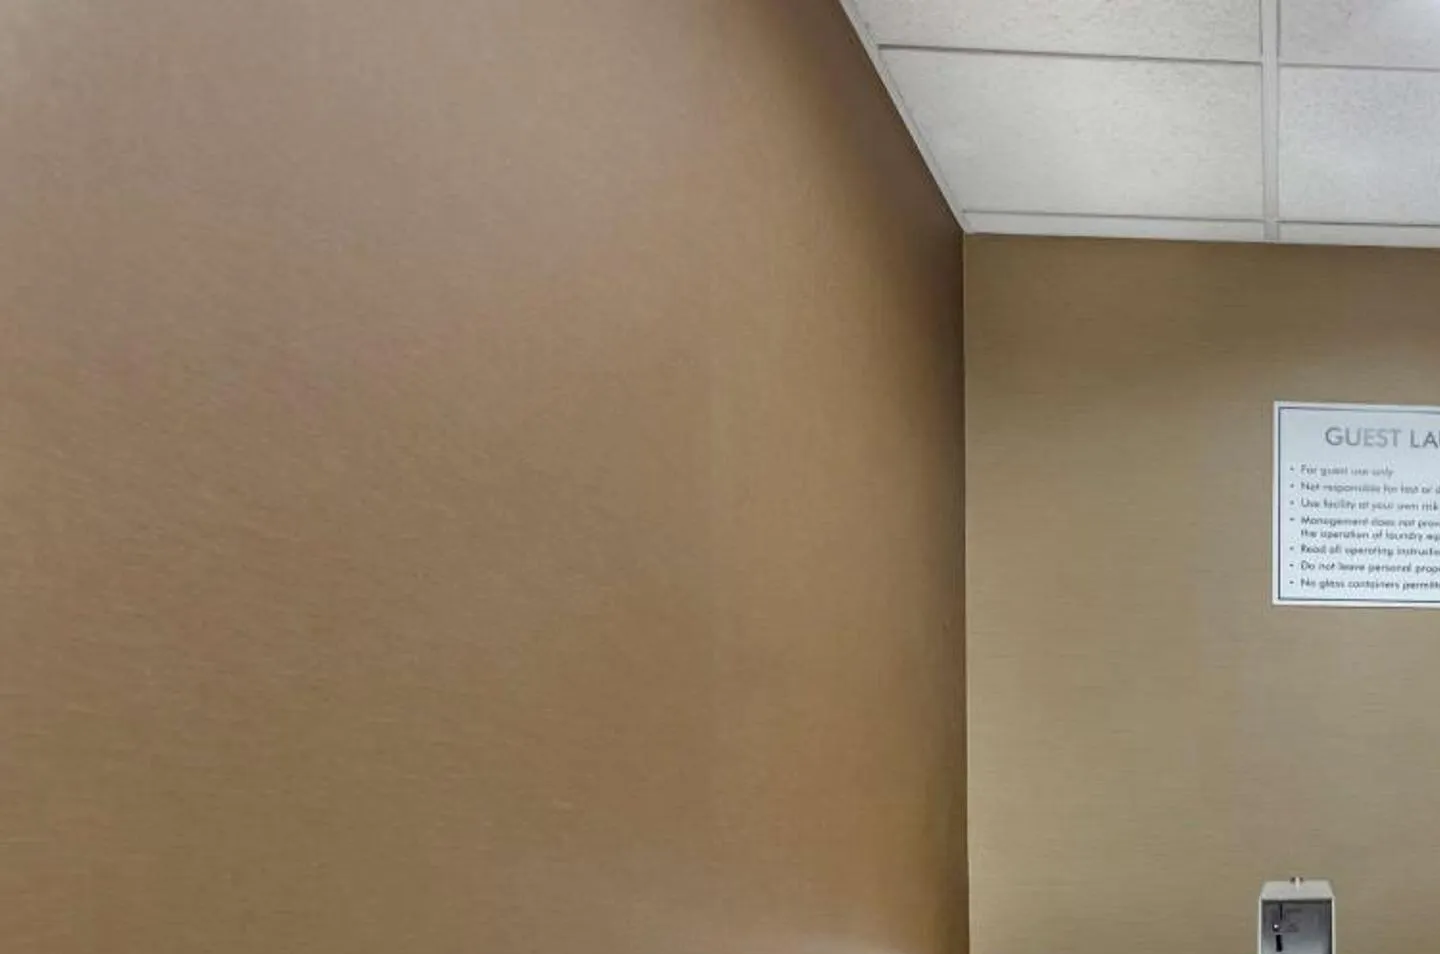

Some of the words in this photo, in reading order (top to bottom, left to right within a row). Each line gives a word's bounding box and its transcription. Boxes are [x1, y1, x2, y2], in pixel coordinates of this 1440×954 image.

[1324, 426, 1402, 447] GUEST
[1300, 464, 1317, 475] For
[1300, 481, 1320, 491] Not
[1322, 483, 1381, 494] responsible
[1383, 483, 1398, 494] for
[1421, 486, 1431, 494] or
[1300, 498, 1320, 508] Use
[1323, 498, 1356, 510] facility
[1371, 502, 1395, 512] your
[1397, 503, 1419, 511] own
[1421, 502, 1439, 512] risk
[1300, 516, 1369, 527] Management
[1371, 518, 1396, 527] does
[1398, 519, 1416, 528] not
[1300, 529, 1318, 539] the
[1319, 530, 1369, 541] operation
[1371, 530, 1383, 540] of
[1385, 530, 1424, 543] laundry
[1300, 545, 1327, 555] Read
[1343, 546, 1395, 558] operating
[1300, 560, 1316, 571] Do
[1318, 562, 1336, 571] not
[1338, 563, 1366, 572] leave
[1367, 563, 1413, 574] personal
[1300, 578, 1317, 588] No
[1319, 579, 1346, 590] glass
[1347, 580, 1401, 590] containers
